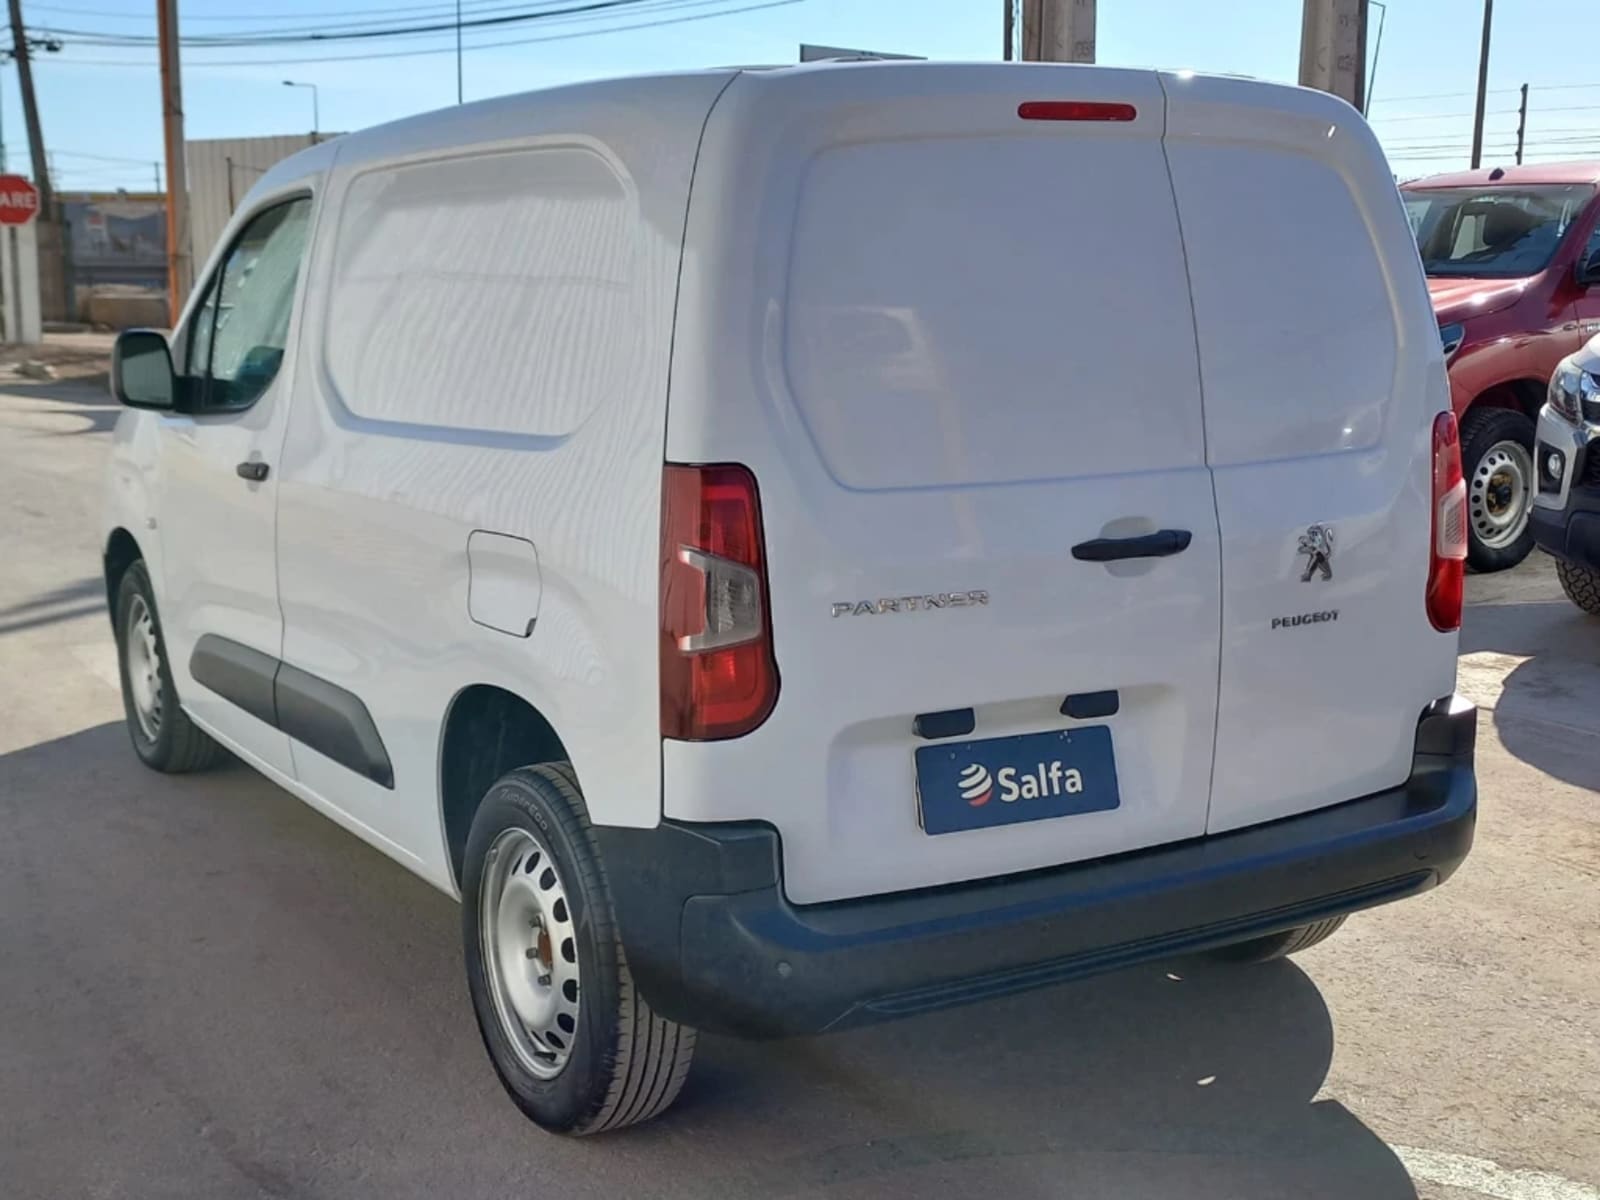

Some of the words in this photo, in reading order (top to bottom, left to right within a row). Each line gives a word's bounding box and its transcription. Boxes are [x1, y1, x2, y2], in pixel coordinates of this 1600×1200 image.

[0, 190, 35, 209] ARE
[831, 589, 991, 618] PARTNER
[1271, 609, 1339, 630] PEUGEOT
[997, 761, 1083, 802] Salfa
